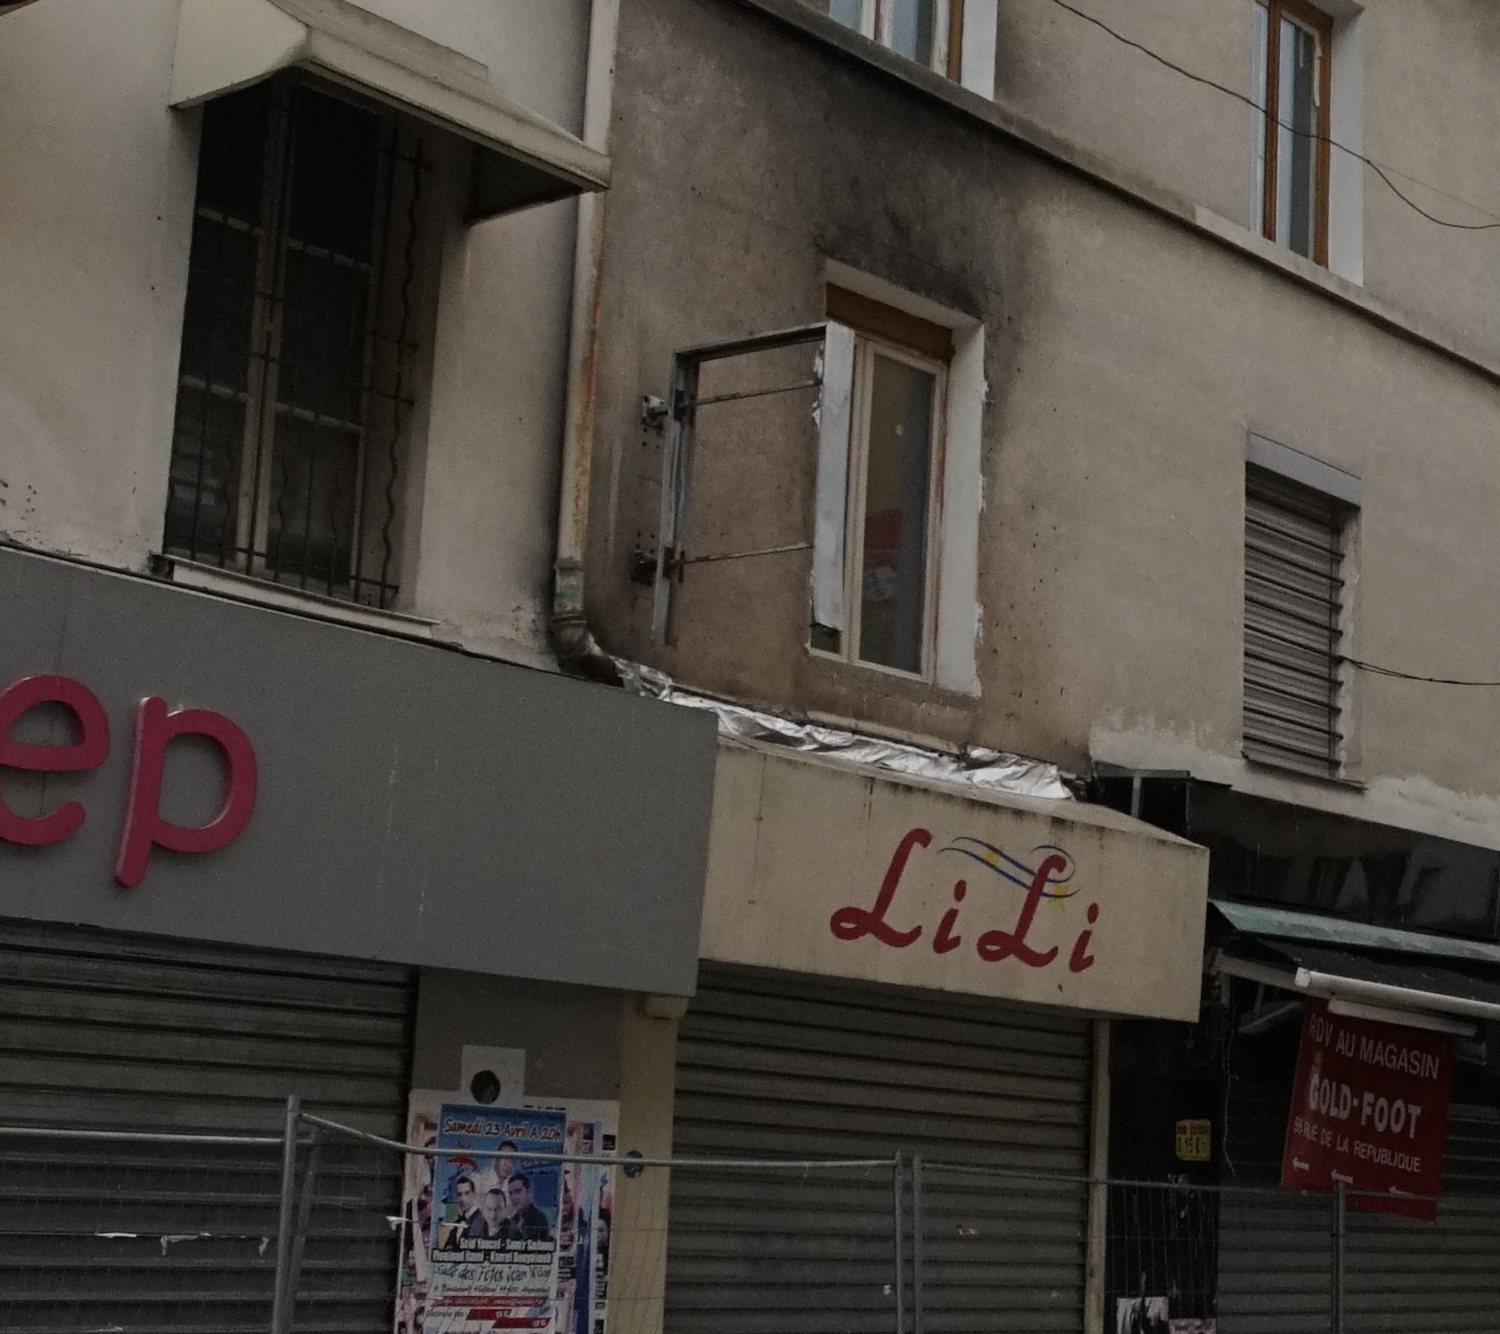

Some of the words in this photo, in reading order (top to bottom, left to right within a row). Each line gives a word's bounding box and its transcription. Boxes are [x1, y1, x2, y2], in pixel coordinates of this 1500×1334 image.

[830, 828, 1098, 973] LiLi
[1309, 1014, 1333, 1048] RDV
[1336, 1029, 1355, 1058] AU
[1359, 1036, 1440, 1080] MAGASIN
[444, 1116, 481, 1134] Samedi
[484, 1121, 500, 1136] 23
[1309, 1073, 1422, 1139] GOLD-FOOT
[1302, 1122, 1317, 1141] RUE
[1321, 1128, 1332, 1147] DE
[1336, 1134, 1349, 1153] LA
[1353, 1140, 1422, 1172] REPUBLIQUE
